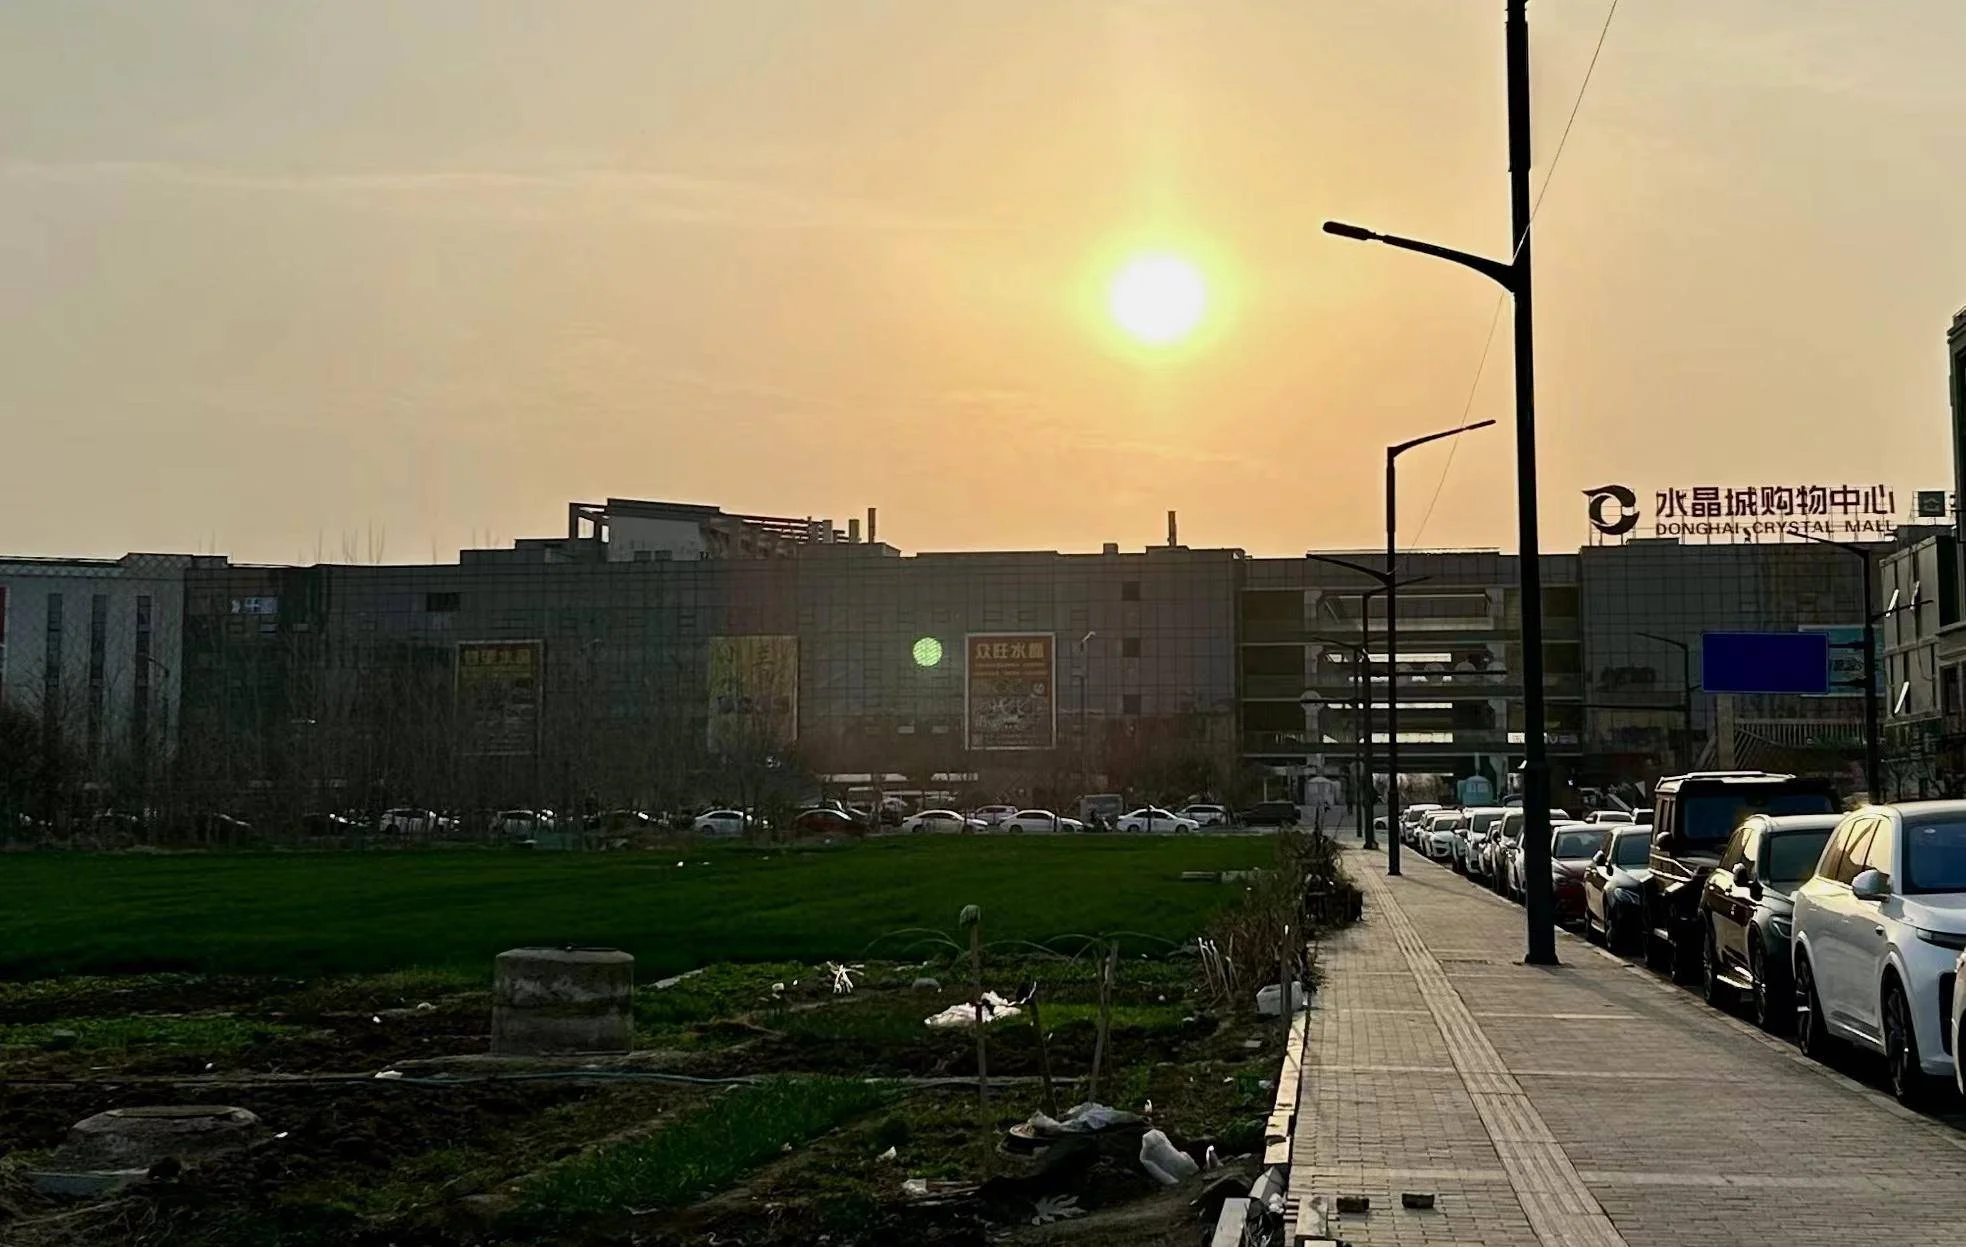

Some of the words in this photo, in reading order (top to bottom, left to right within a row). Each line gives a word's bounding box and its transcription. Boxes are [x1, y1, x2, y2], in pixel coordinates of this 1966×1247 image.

[1656, 485, 1895, 517] 水晶城购物中心
[1656, 522, 1739, 535] DONGHAI
[1752, 521, 1834, 534] CRYSTAL
[1845, 520, 1897, 533] MALL
